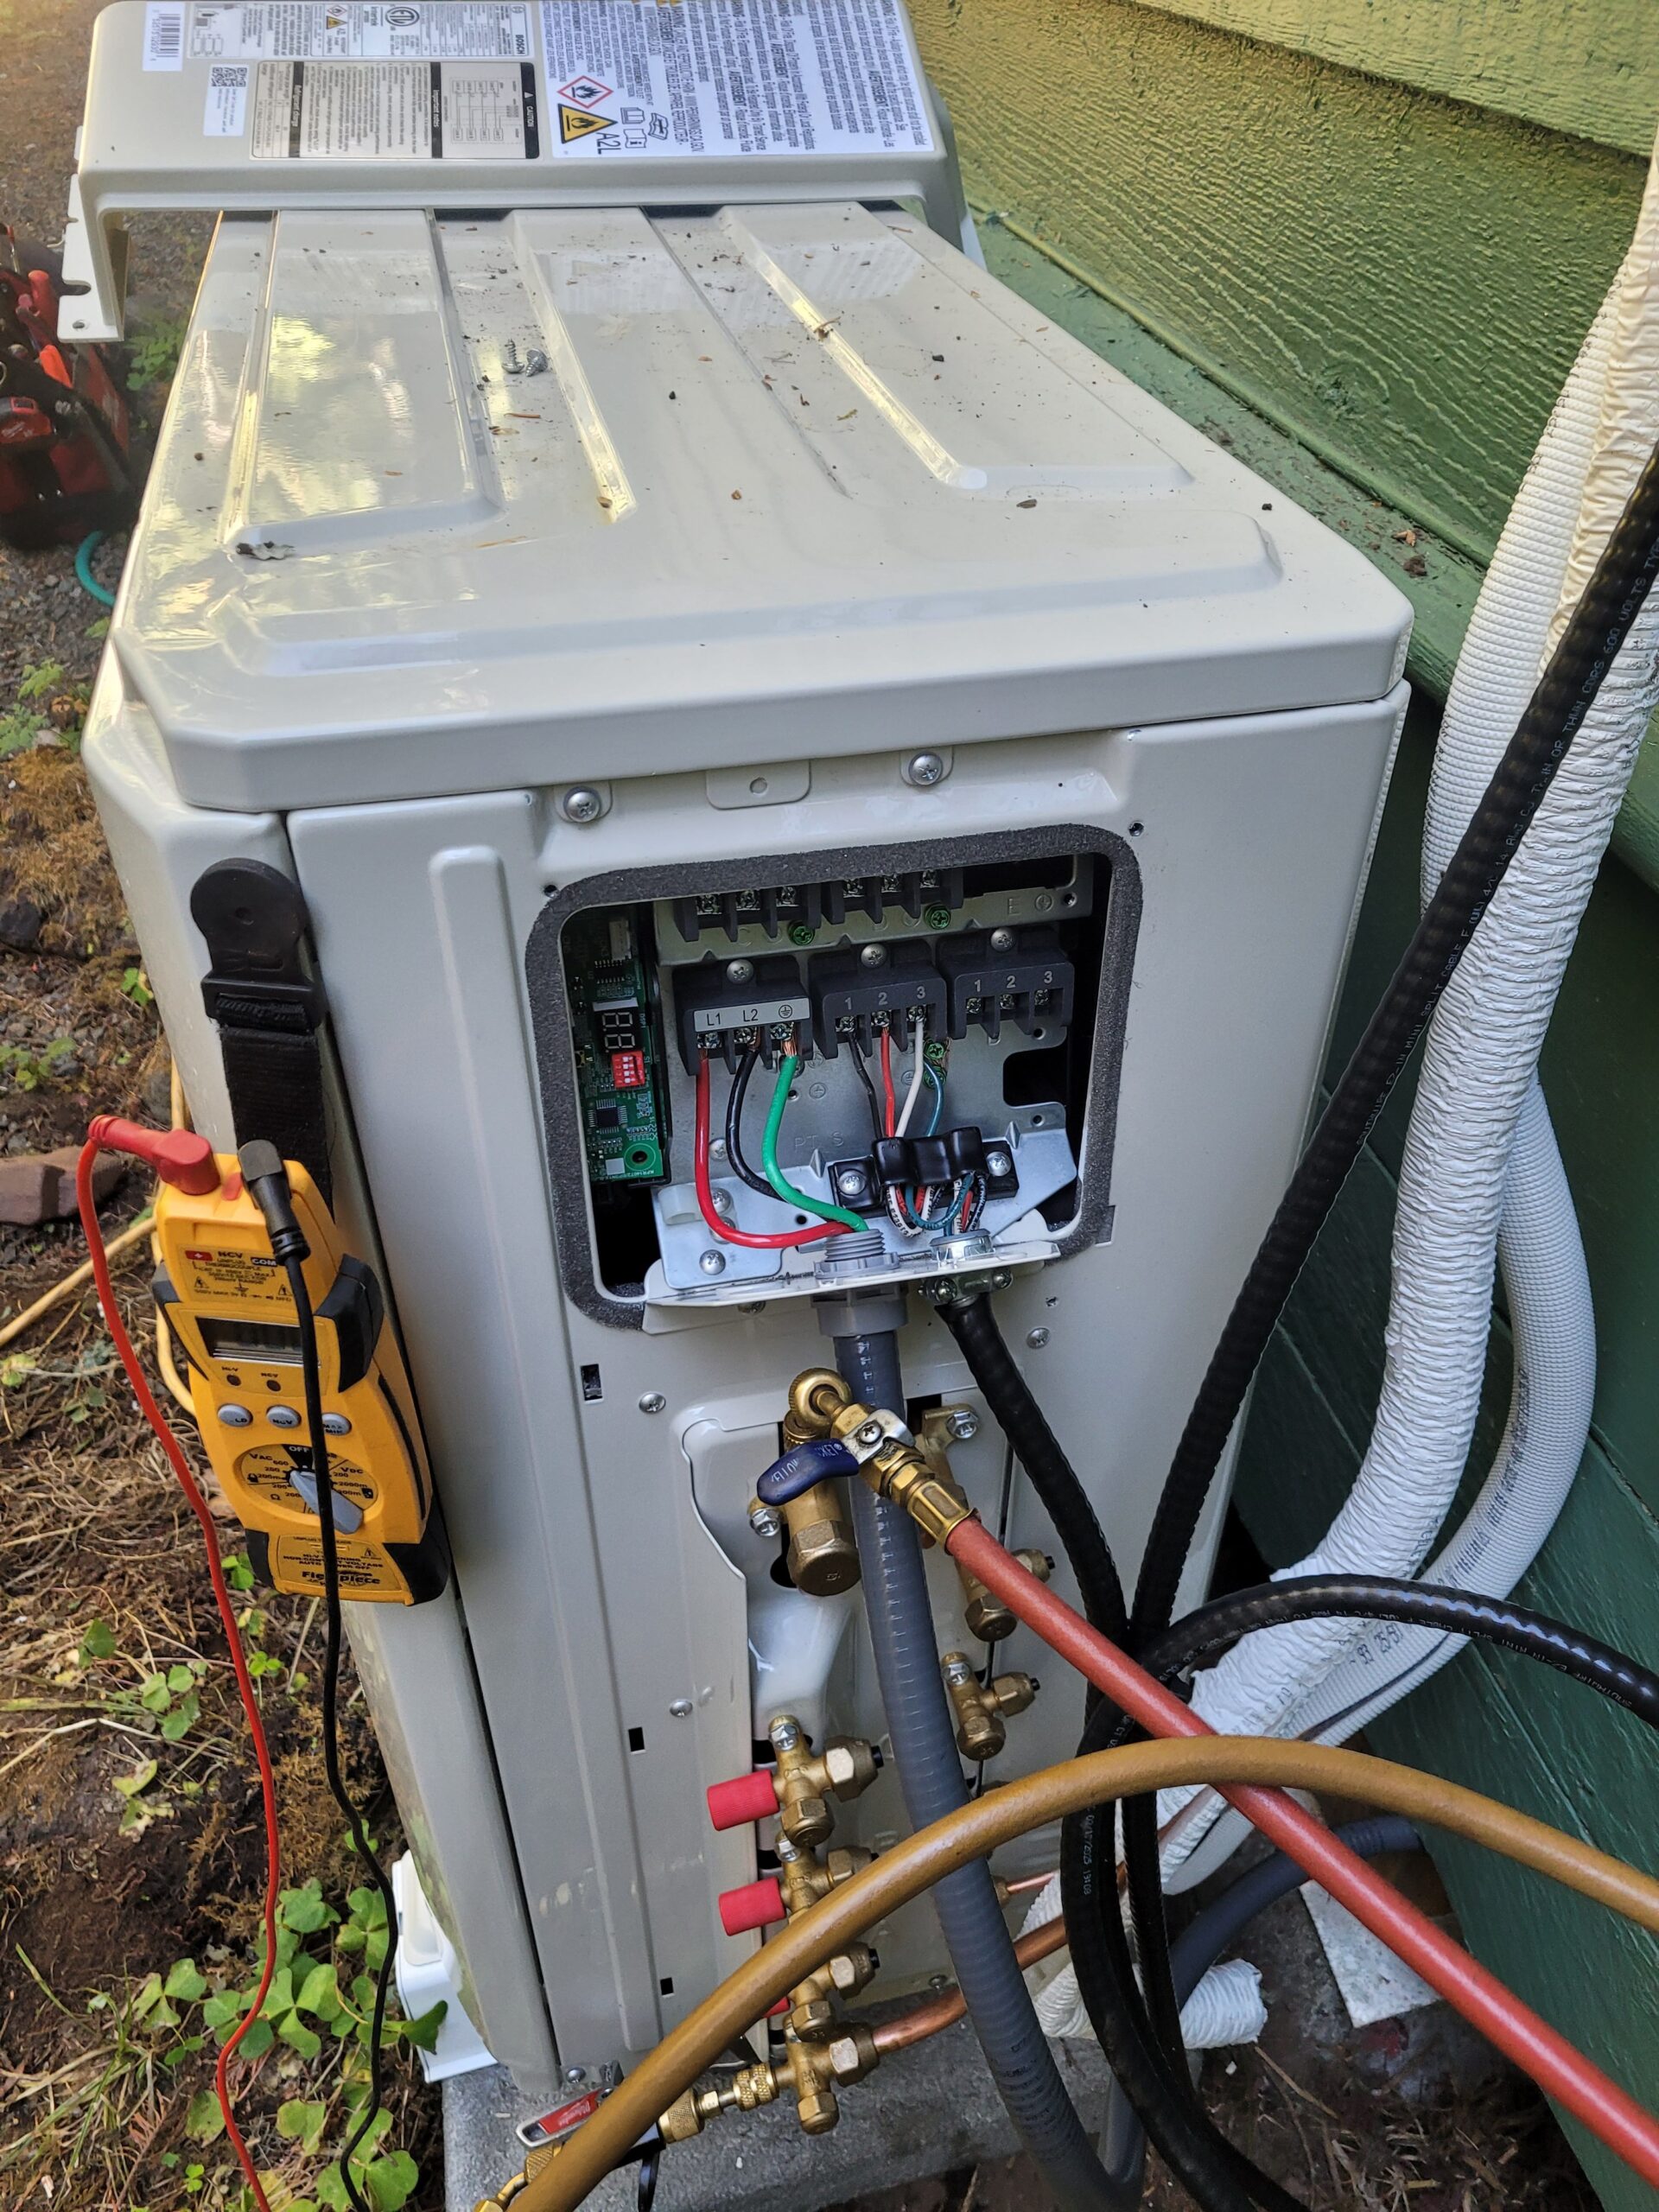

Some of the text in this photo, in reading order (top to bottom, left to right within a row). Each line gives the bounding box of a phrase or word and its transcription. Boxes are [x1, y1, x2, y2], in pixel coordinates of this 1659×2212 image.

[516, 35, 525, 54] BOSCH
[432, 89, 442, 127] Important notes
[525, 105, 534, 127] CAUTION
[596, 131, 620, 154] A2L
[1403, 1021, 1423, 1050] MINI
[1419, 982, 1444, 1019] SPLIT
[1439, 942, 1464, 979] CABLE
[1494, 850, 1510, 868] 14
[1548, 738, 1566, 759] OR
[1599, 626, 1622, 655] 600
[1615, 574, 1649, 622] VOLTS
[974, 970, 1053, 992] 1 2 3
[845, 986, 926, 1010] 1 2 3
[707, 1008, 759, 1027] L1 L2
[251, 1258, 276, 1267] COM
[302, 1571, 381, 1585] Fiepiece
